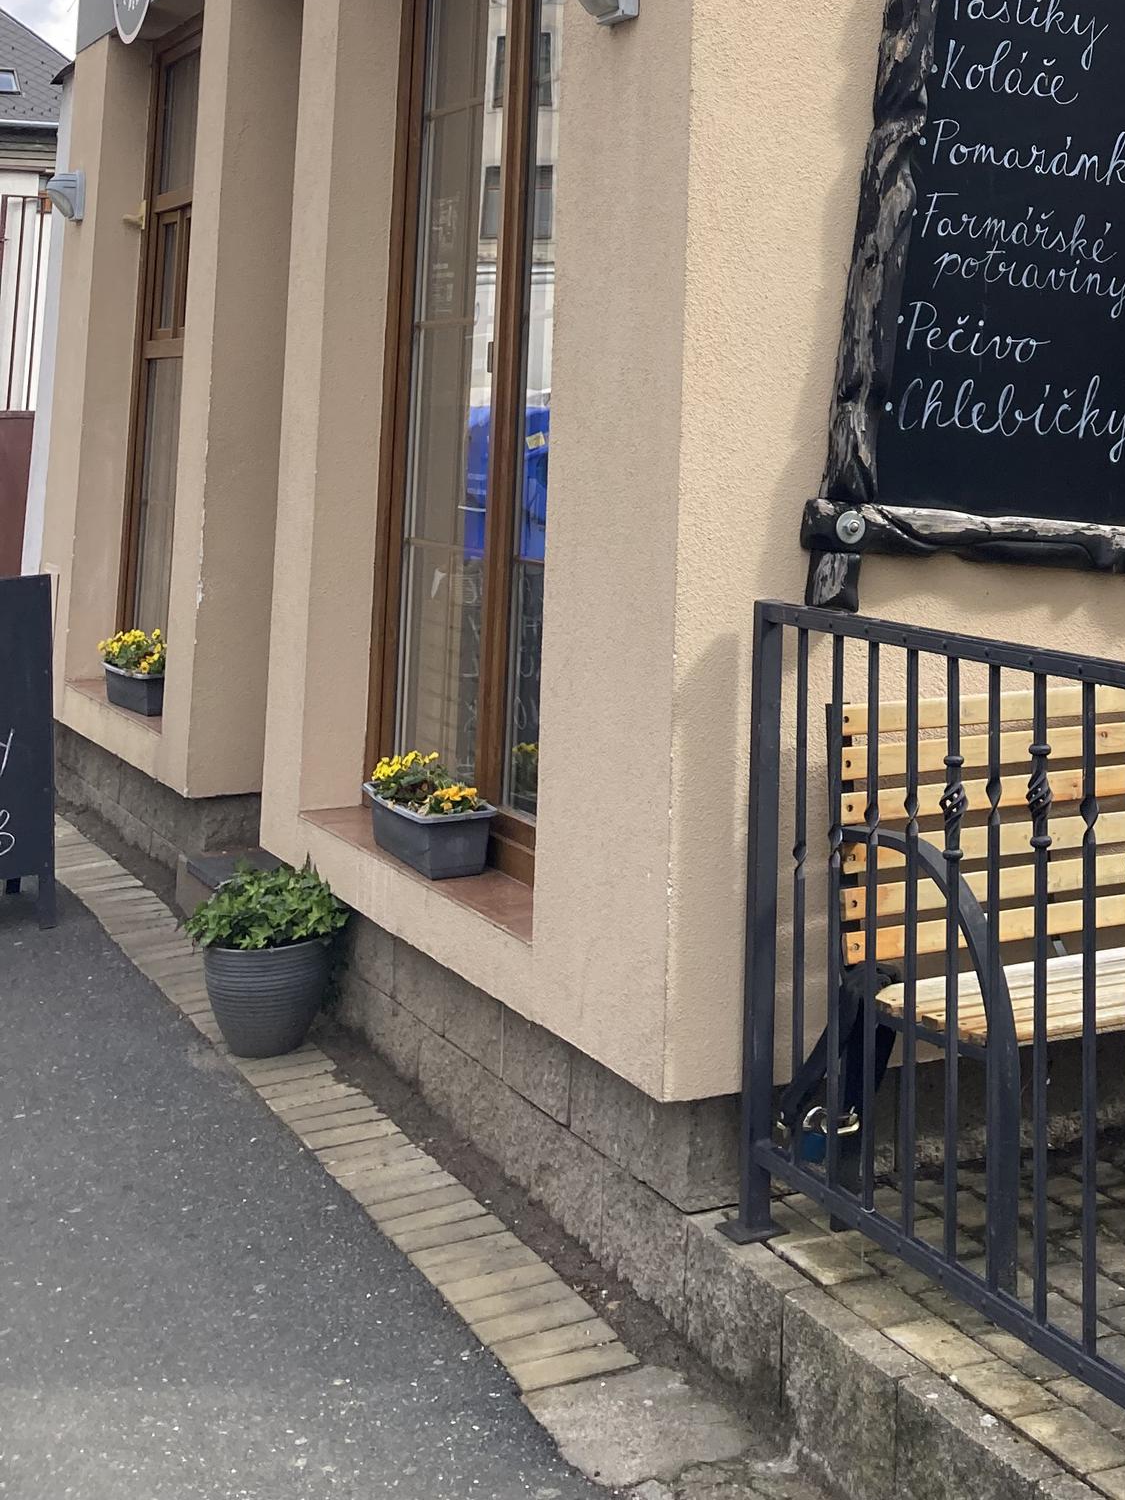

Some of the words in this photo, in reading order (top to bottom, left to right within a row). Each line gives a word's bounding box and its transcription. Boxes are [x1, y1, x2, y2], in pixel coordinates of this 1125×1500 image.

[941, 39, 1079, 105] Koláče
[921, 192, 1118, 263] Farmářské
[905, 301, 1051, 363] Pečivo
